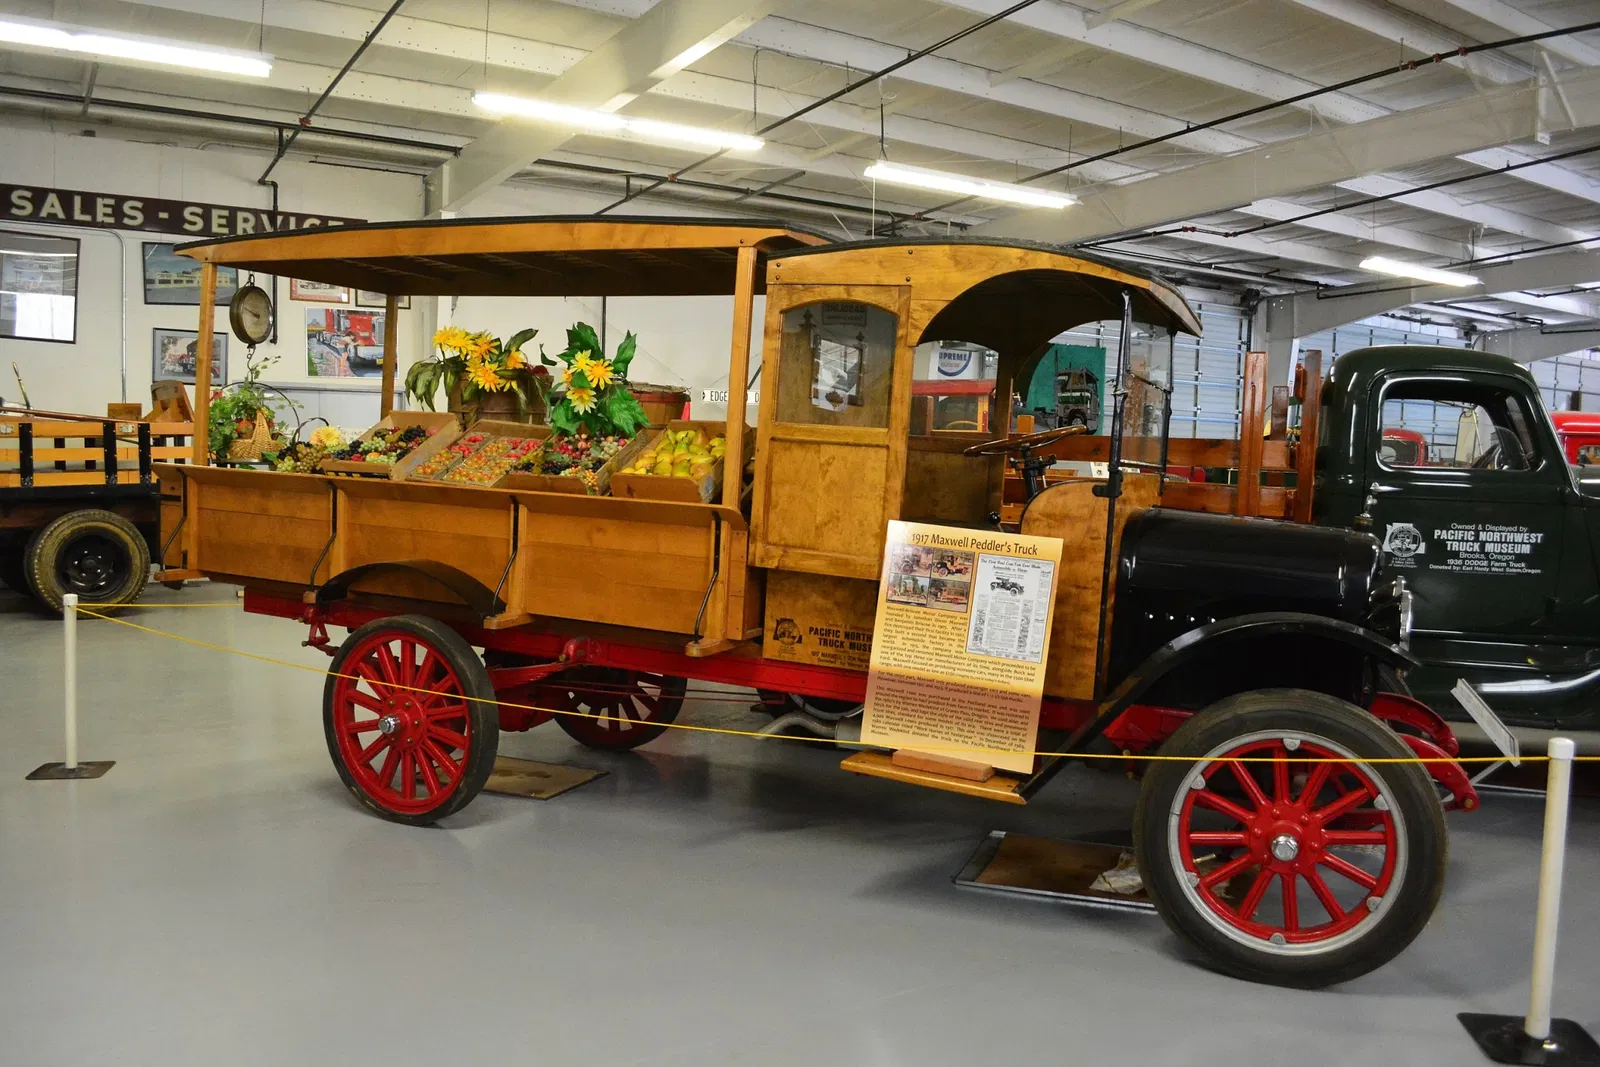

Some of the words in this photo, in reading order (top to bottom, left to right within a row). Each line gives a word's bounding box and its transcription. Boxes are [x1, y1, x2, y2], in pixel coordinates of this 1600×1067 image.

[10, 189, 144, 226] SALES
[182, 206, 344, 236] SERVI
[939, 352, 967, 361] UPREME
[1434, 530, 1475, 540] PACIFIC
[1479, 532, 1544, 543] NORTHWEST
[911, 532, 929, 544] 1917
[930, 533, 969, 548] Maxwell
[970, 537, 1011, 553] Peddler's
[1012, 542, 1038, 555] Truck
[1446, 541, 1480, 552] TRUCK
[1484, 543, 1531, 554] MUSEUM
[1489, 553, 1515, 561] Oregon
[808, 627, 841, 638] PACIFIC
[844, 631, 873, 642] NORTH
[818, 638, 845, 648] TRUCK
[849, 642, 872, 652] MUSE
